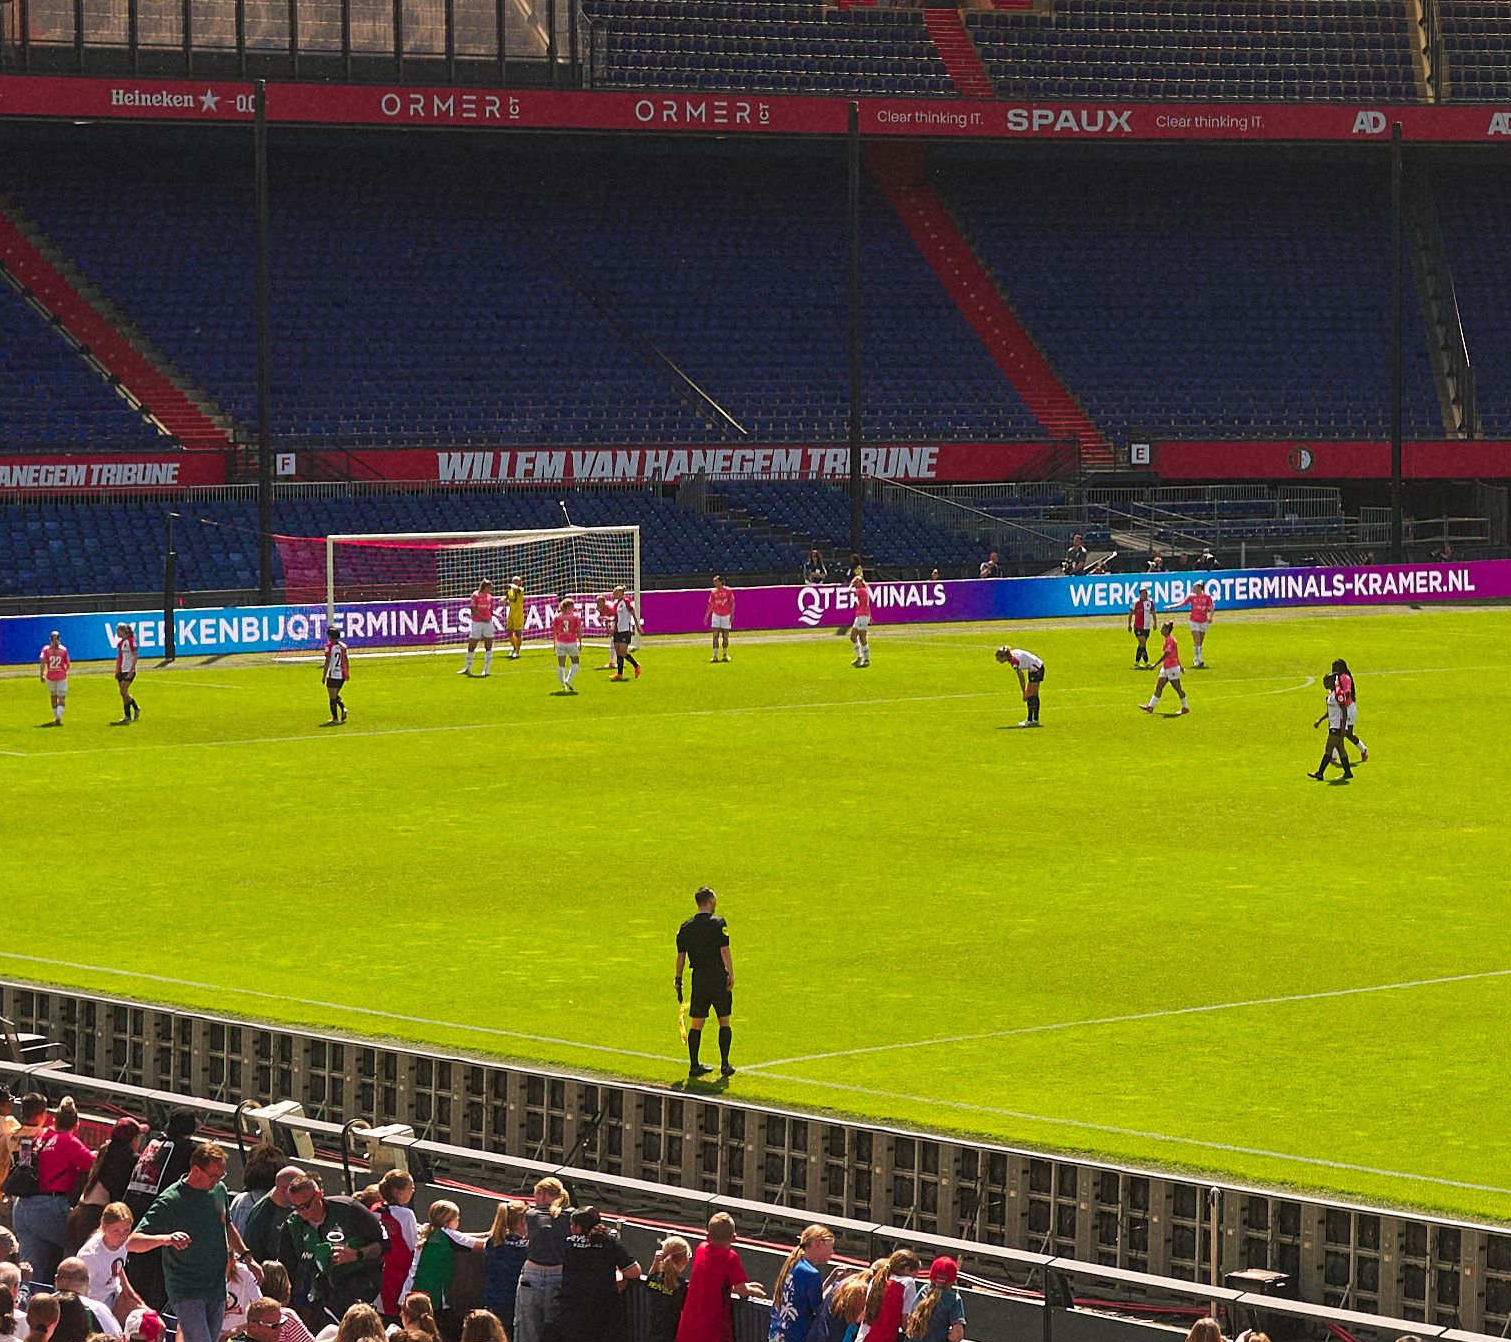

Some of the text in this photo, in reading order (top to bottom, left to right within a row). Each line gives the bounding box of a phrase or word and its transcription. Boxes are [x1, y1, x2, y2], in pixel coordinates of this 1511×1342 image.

[110, 88, 195, 109] Heineken
[380, 92, 500, 117] ORMER
[635, 99, 751, 124] ORMER
[876, 110, 984, 127] Clear thinking IT.
[1007, 108, 1133, 133] SPAUX
[1155, 114, 1265, 132] Clear thinking IT.
[1352, 110, 1387, 134] AD
[88, 461, 181, 486] TRIBUNE
[437, 451, 569, 483] WILLEM
[572, 450, 645, 482] VAN
[647, 447, 802, 481] HANEGEM
